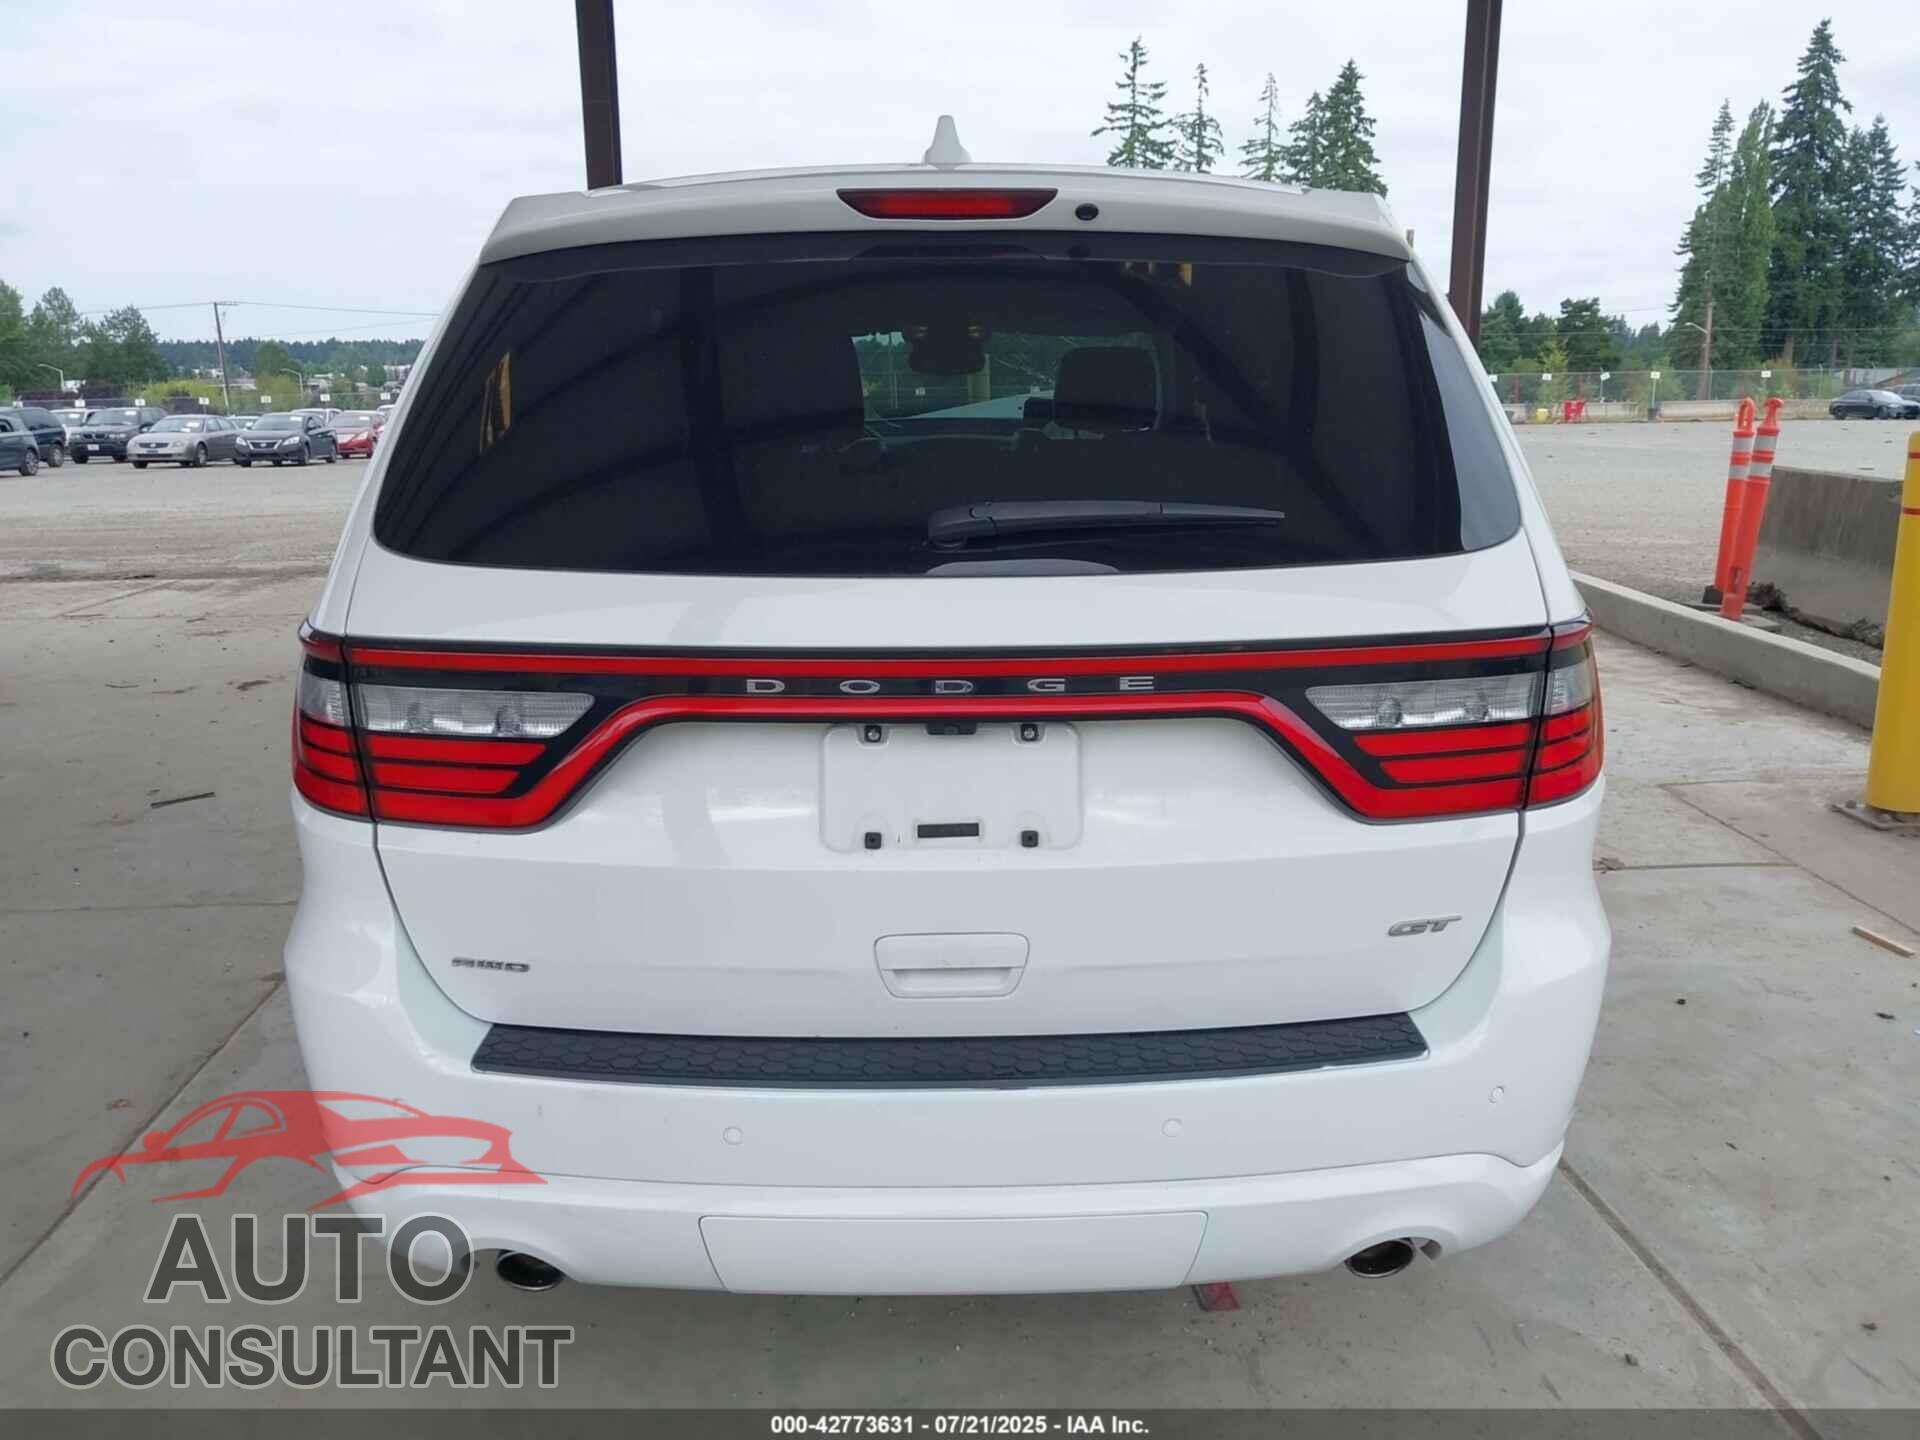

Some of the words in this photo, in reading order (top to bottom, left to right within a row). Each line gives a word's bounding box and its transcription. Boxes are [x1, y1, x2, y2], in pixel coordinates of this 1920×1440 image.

[746, 675, 1155, 695] DODGE
[1388, 915, 1463, 936] GT
[451, 957, 530, 973] AWD
